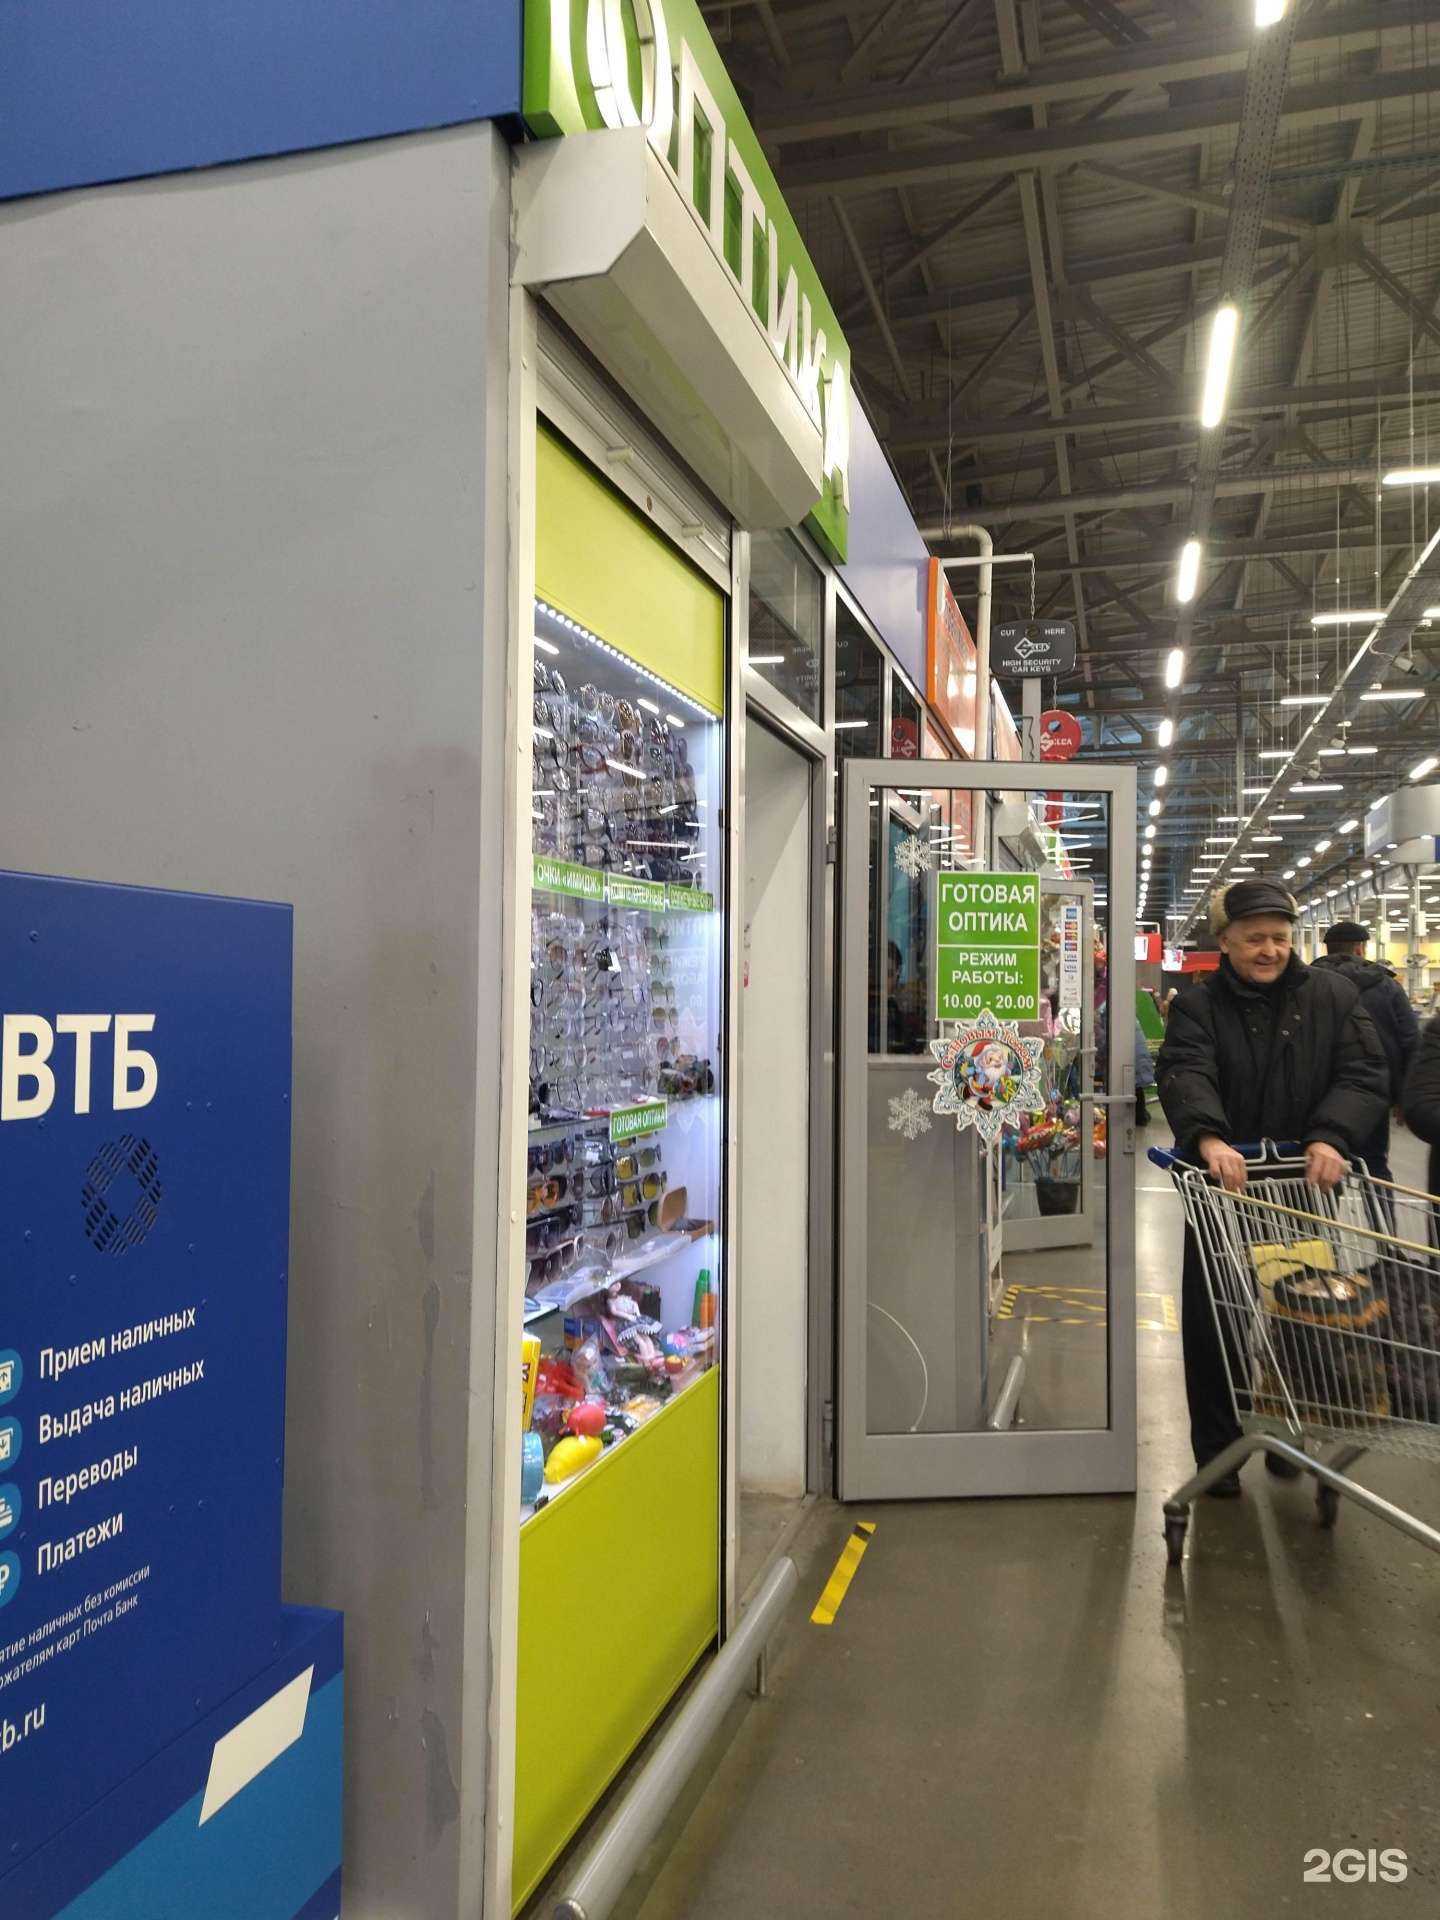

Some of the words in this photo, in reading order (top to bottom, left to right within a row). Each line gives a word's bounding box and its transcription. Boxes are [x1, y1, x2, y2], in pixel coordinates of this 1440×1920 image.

[1000, 629, 1016, 637] CUT
[1044, 627, 1066, 635] HERE
[1002, 659, 1022, 667] HIGH
[1023, 658, 1062, 667] SECURITY
[1030, 665, 1051, 673] KEYS
[537, 865, 561, 884] ОЧКИ
[942, 884, 1035, 903] ГОТОВАЯ
[948, 911, 1028, 932] ОПТИКА
[959, 952, 1017, 966] РЕЖИМ
[952, 970, 1023, 985] РАБОТЫ:
[943, 994, 981, 1008] 10.00
[996, 995, 1034, 1009] 20.00
[1, 1014, 158, 1121] ВТБ
[613, 1111, 642, 1134] ГОТОВАЯ
[40, 1338, 105, 1381] Прием
[111, 1307, 196, 1354] наличных
[39, 1396, 115, 1444] Выдача
[120, 1360, 204, 1411] наличных
[38, 1445, 138, 1510] Переводы
[37, 1512, 123, 1576] Платежи
[28, 1604, 82, 1646] наличных
[84, 1595, 102, 1613] без
[103, 1565, 150, 1600] комиссии
[56, 1628, 81, 1654] карт
[83, 1609, 113, 1638] Почта
[115, 1594, 138, 1618] Банк
[0, 1702, 46, 1754] b.ru
